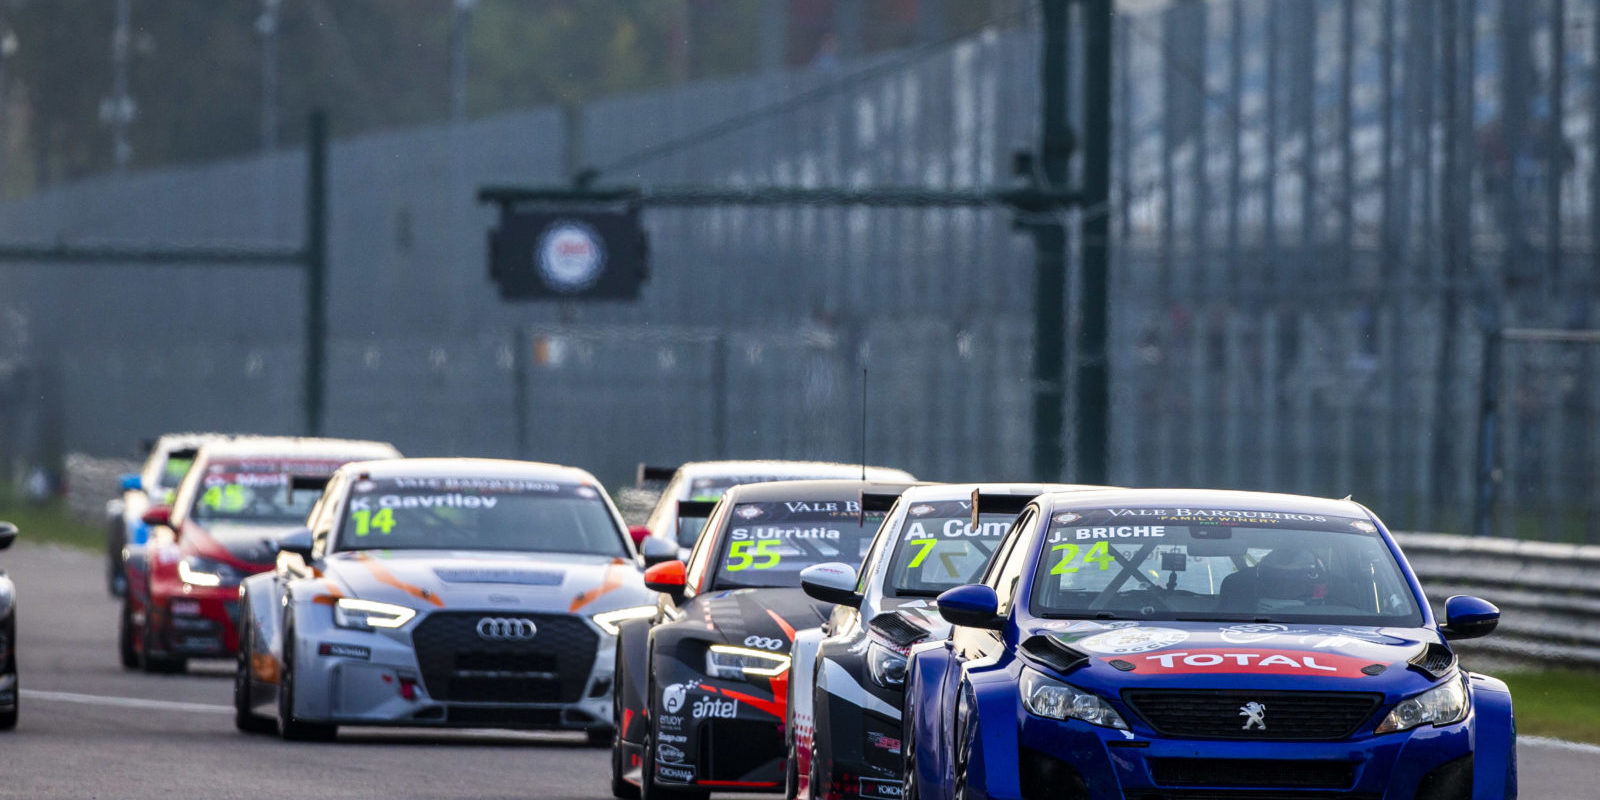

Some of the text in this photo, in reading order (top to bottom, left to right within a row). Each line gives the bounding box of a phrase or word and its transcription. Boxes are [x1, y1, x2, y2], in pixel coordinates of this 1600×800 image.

[785, 501, 837, 513] VALE
[1107, 508, 1327, 522] VALE BARQUEIROS
[352, 508, 396, 537] 14
[904, 522, 934, 541] A.
[732, 527, 840, 540] S.Urrutia
[1048, 526, 1166, 543] J. BRICHE
[726, 539, 781, 572] 55
[907, 538, 938, 569] 7
[1050, 541, 1115, 576] 24
[1146, 652, 1337, 671] TOTAL
[692, 696, 738, 718] antel
